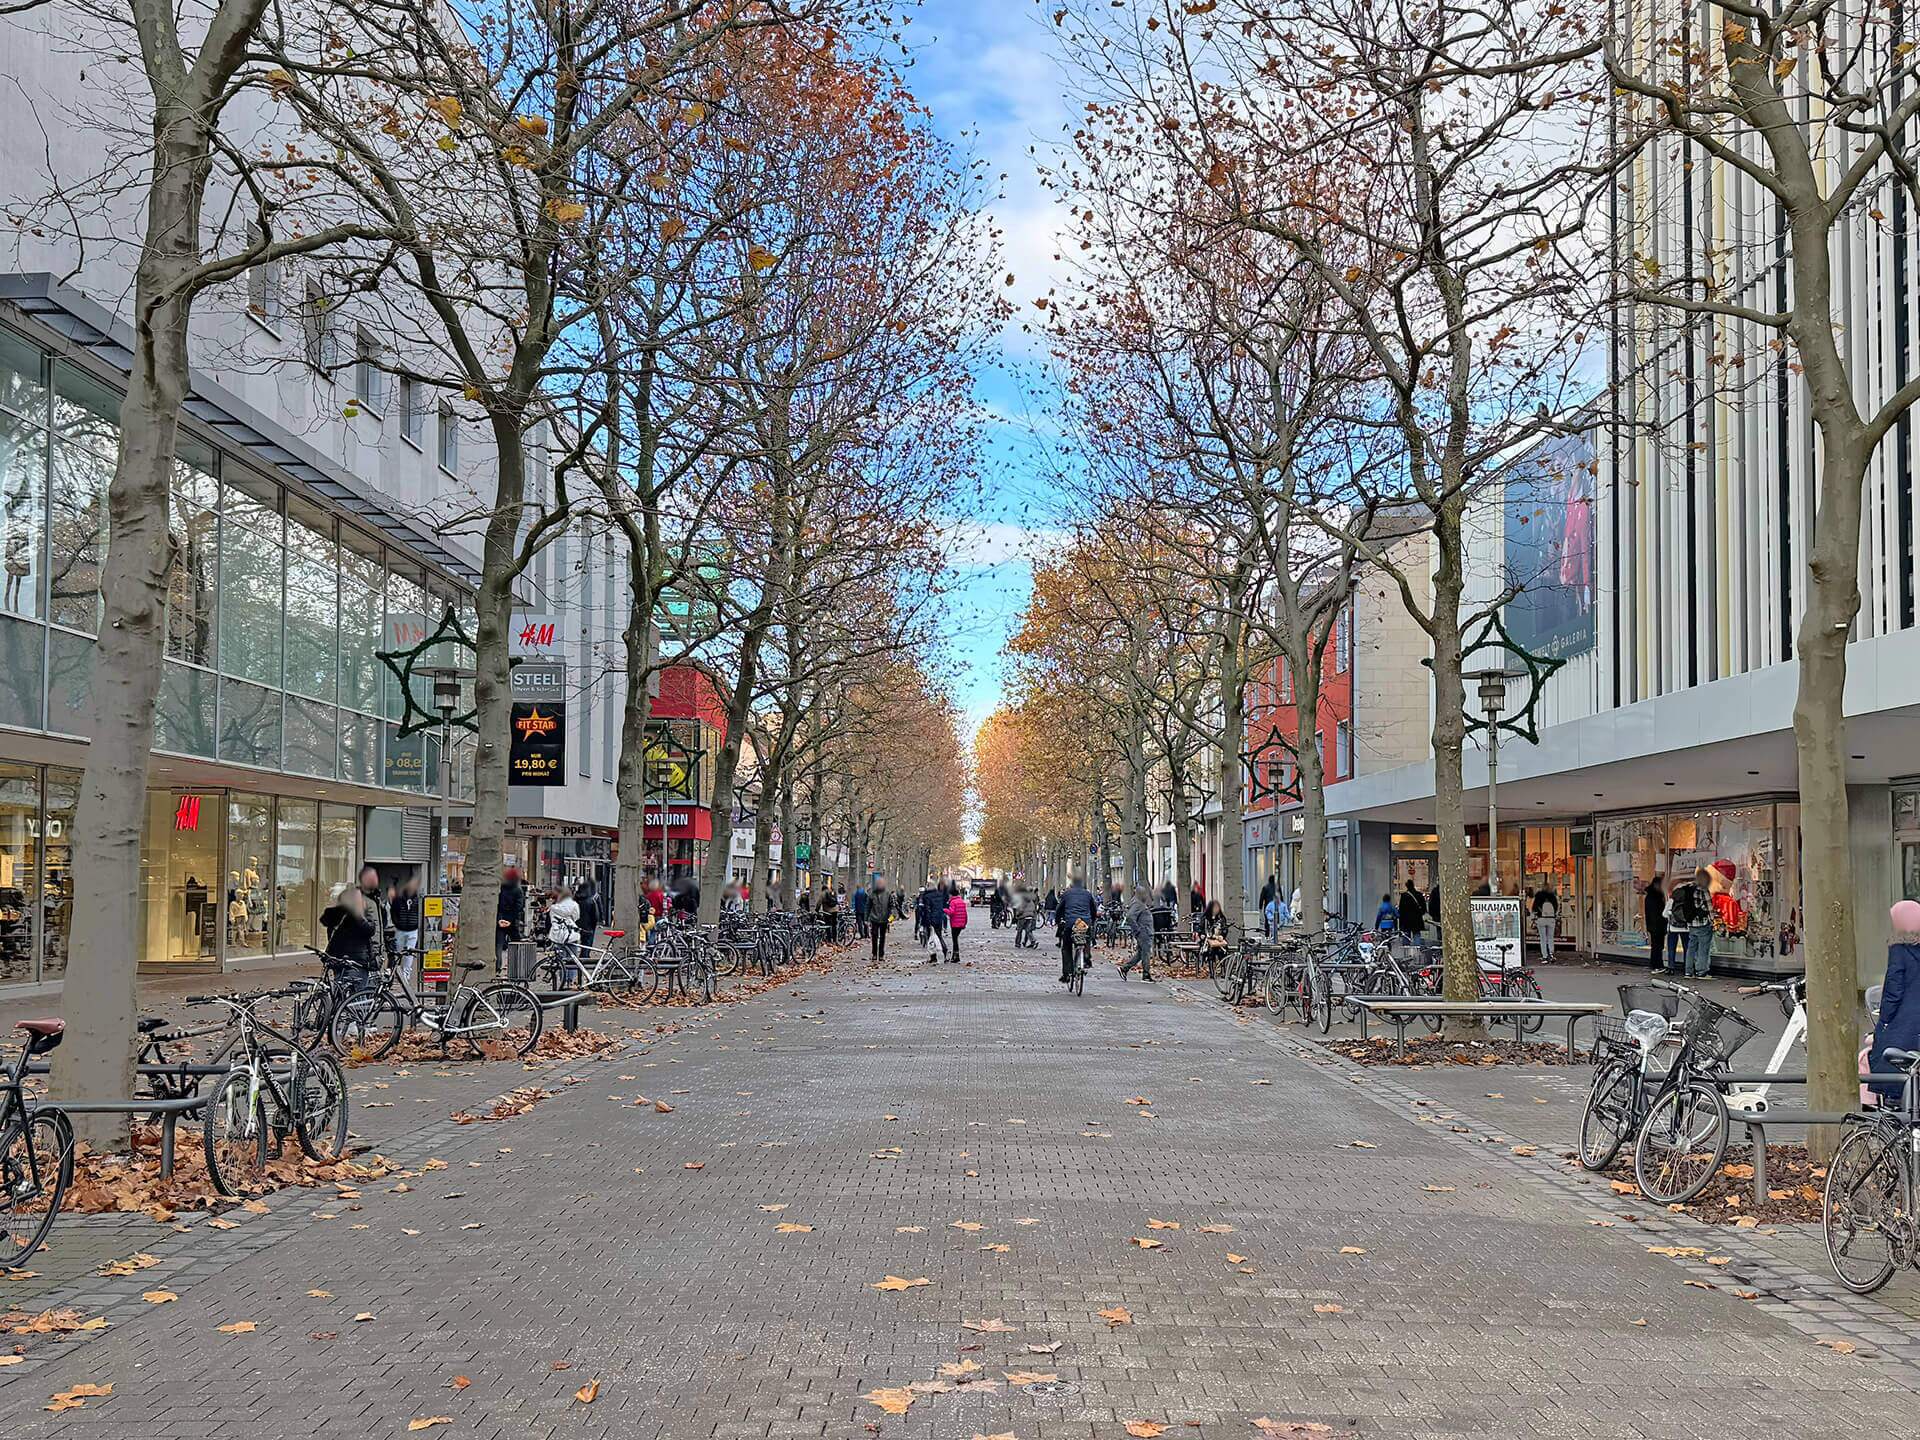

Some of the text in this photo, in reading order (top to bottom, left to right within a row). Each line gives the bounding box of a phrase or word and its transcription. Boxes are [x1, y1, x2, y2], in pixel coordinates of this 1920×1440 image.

[519, 623, 555, 647] H&M
[513, 673, 560, 685] STEEL
[518, 720, 554, 730] FIT STAR
[514, 759, 558, 770] 19,80 €
[645, 813, 688, 826] SATURN
